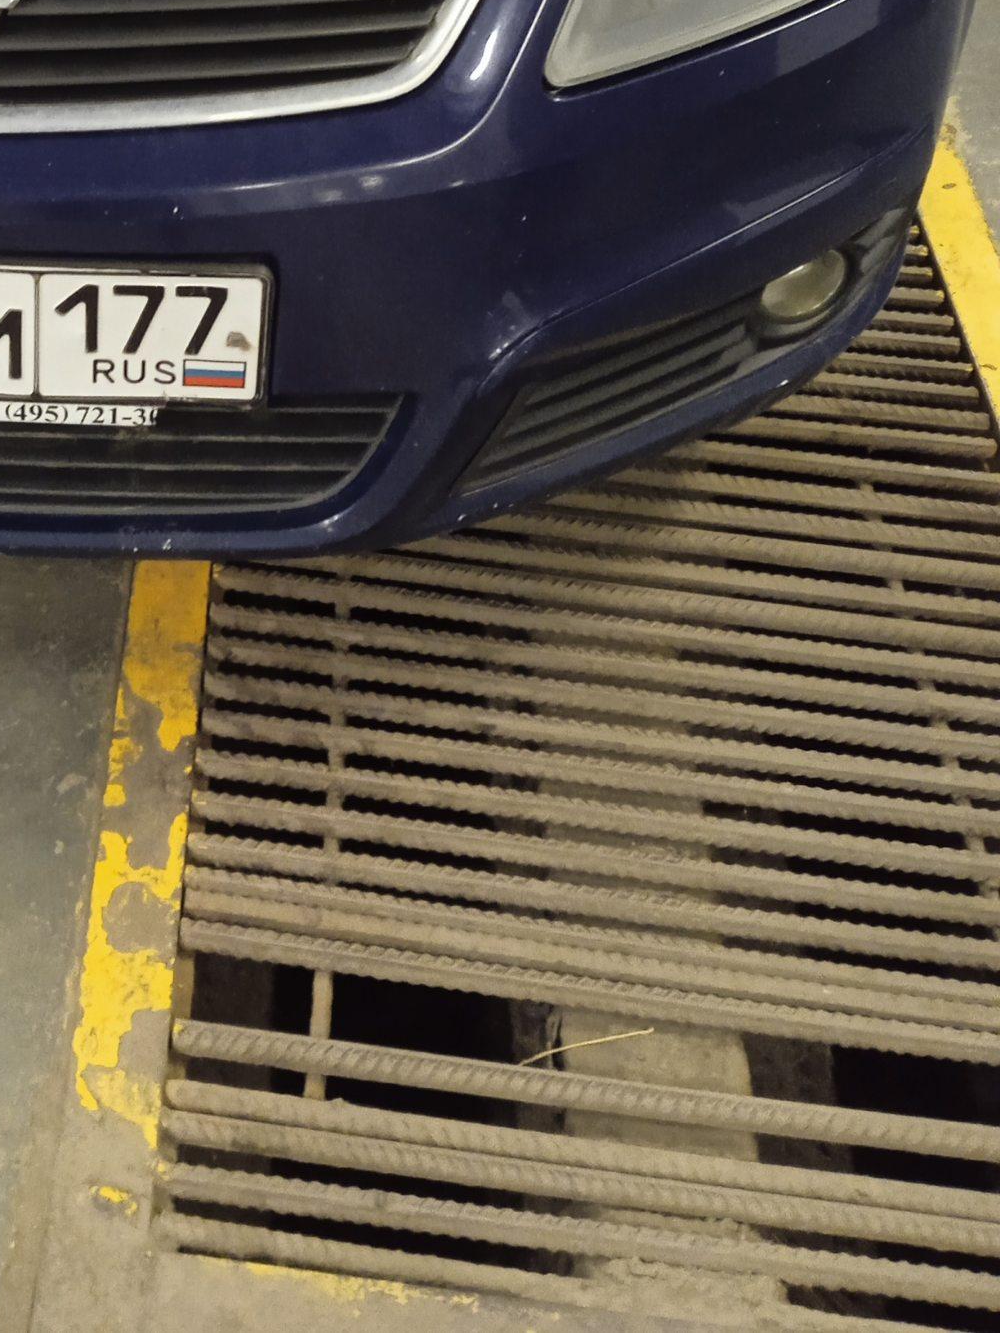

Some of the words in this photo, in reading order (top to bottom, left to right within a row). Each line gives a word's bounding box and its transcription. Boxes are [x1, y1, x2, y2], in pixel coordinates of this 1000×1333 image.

[54, 284, 229, 356] 177
[92, 358, 177, 385] RUS
[5, 403, 69, 423] (495)
